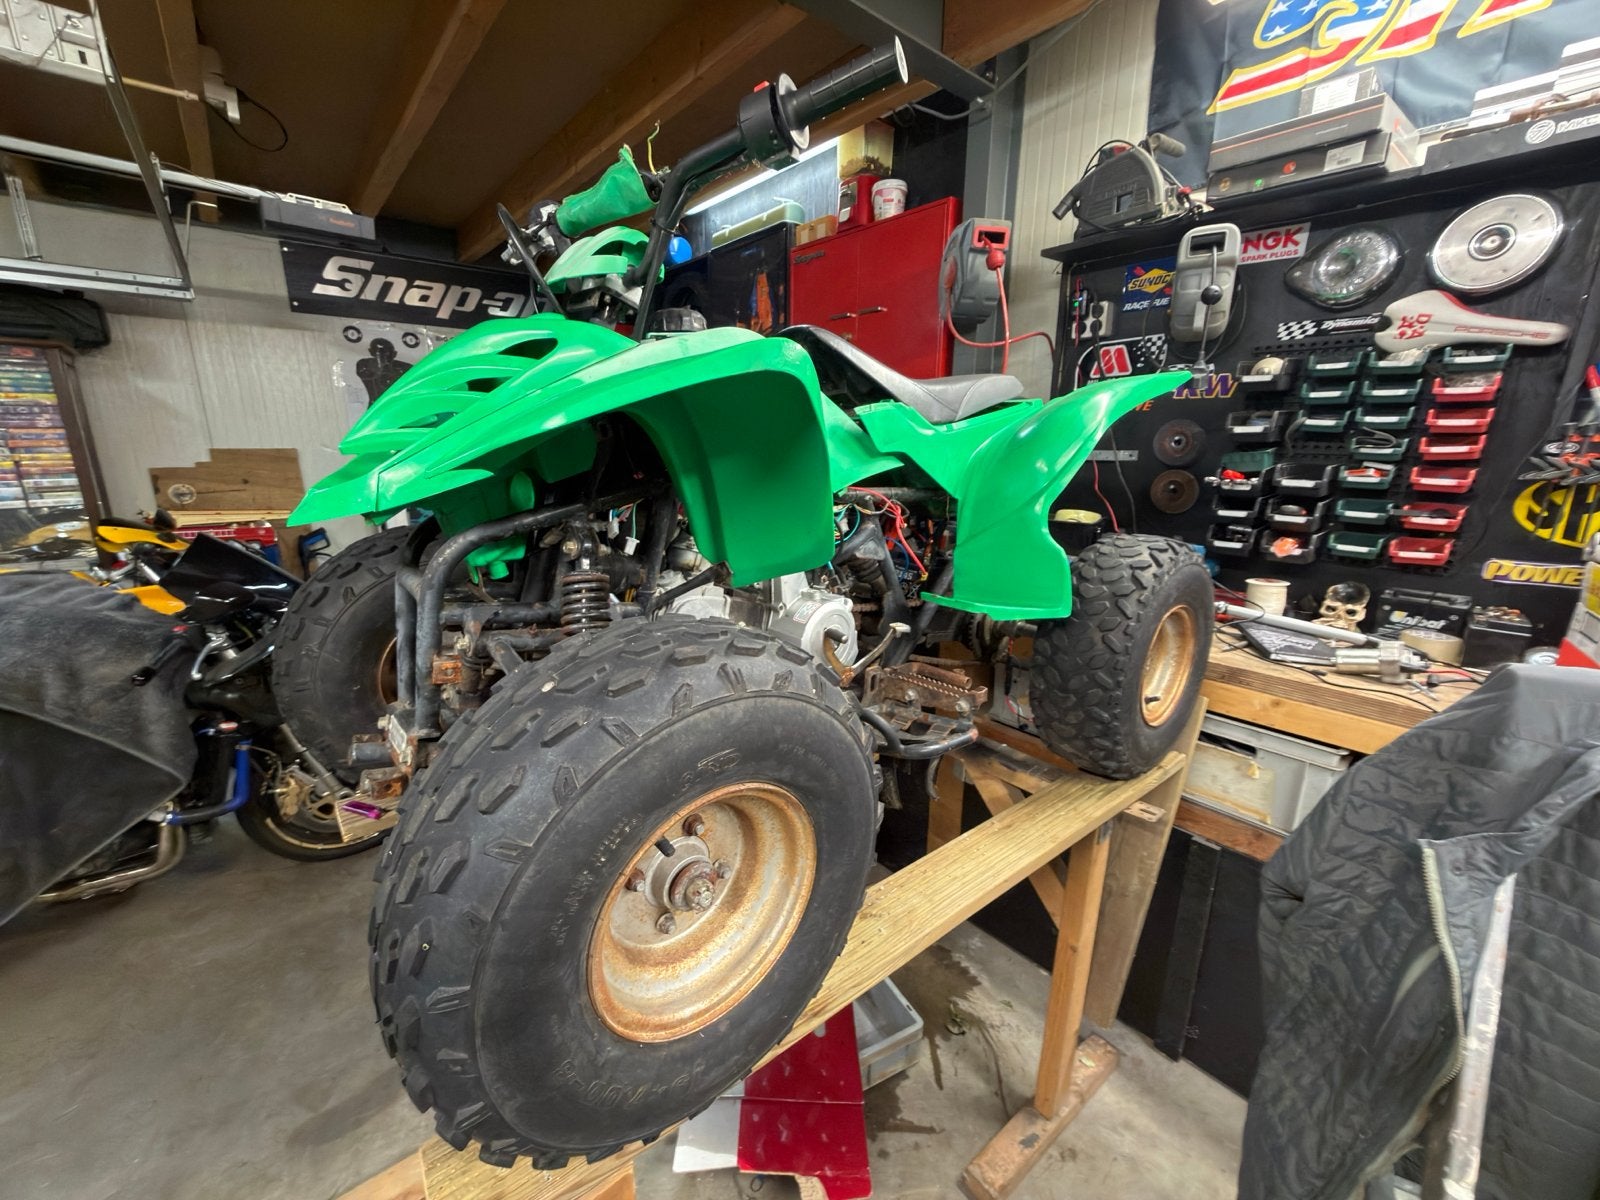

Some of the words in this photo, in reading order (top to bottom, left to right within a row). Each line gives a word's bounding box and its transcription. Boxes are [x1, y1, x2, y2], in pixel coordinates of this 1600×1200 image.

[1242, 226, 1304, 254] NGK
[1241, 253, 1267, 262] SPARK
[1270, 249, 1299, 258] PLUGS
[1129, 273, 1175, 289] SUNOC
[1484, 561, 1583, 586] POWE
